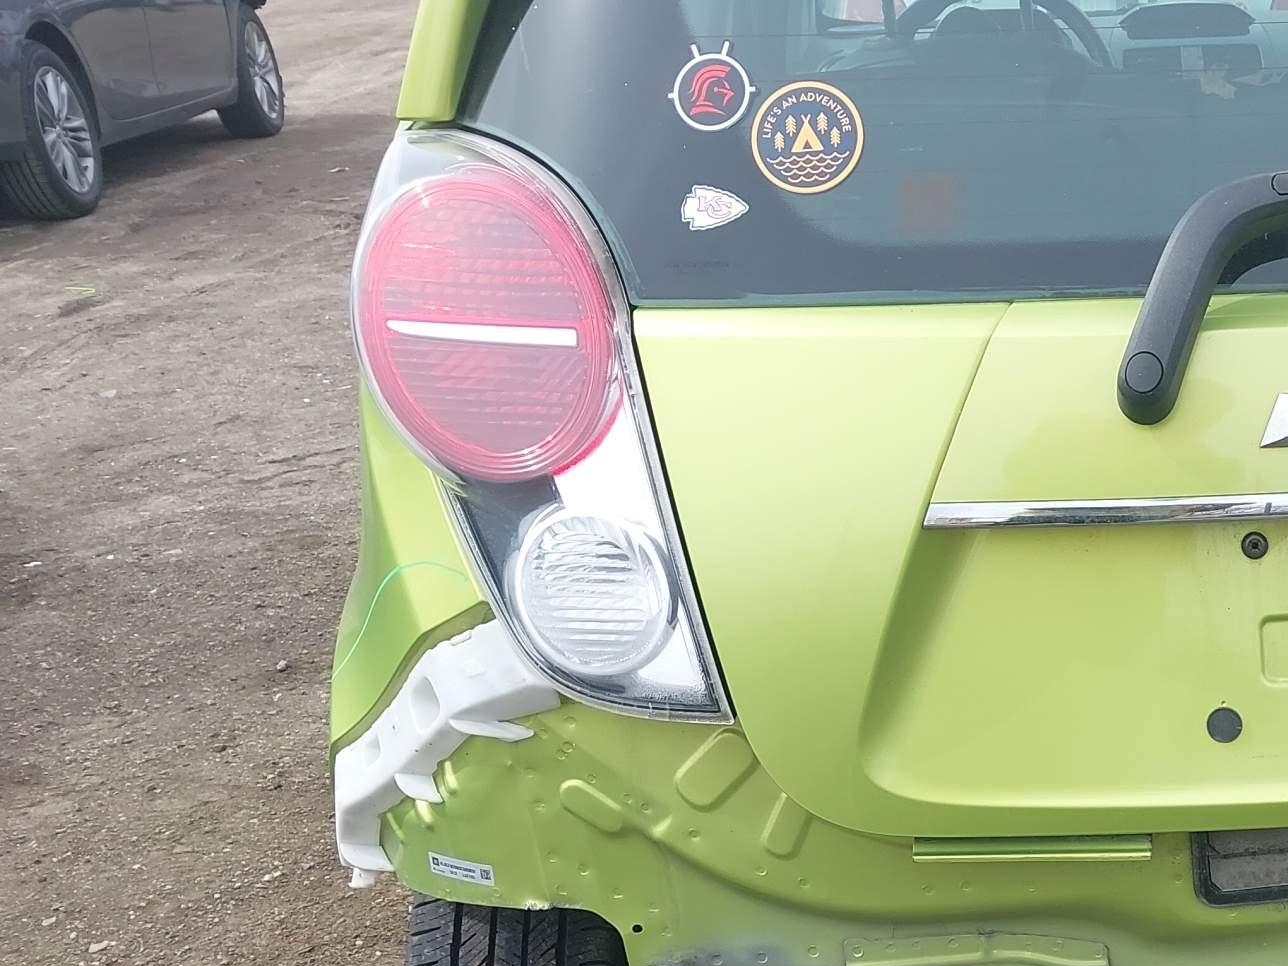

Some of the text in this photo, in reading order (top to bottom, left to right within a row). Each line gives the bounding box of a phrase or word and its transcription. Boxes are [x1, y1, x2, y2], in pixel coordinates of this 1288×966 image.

[762, 92, 852, 138] LIFE'S AN ADVENTURE
[697, 195, 732, 219] KC
